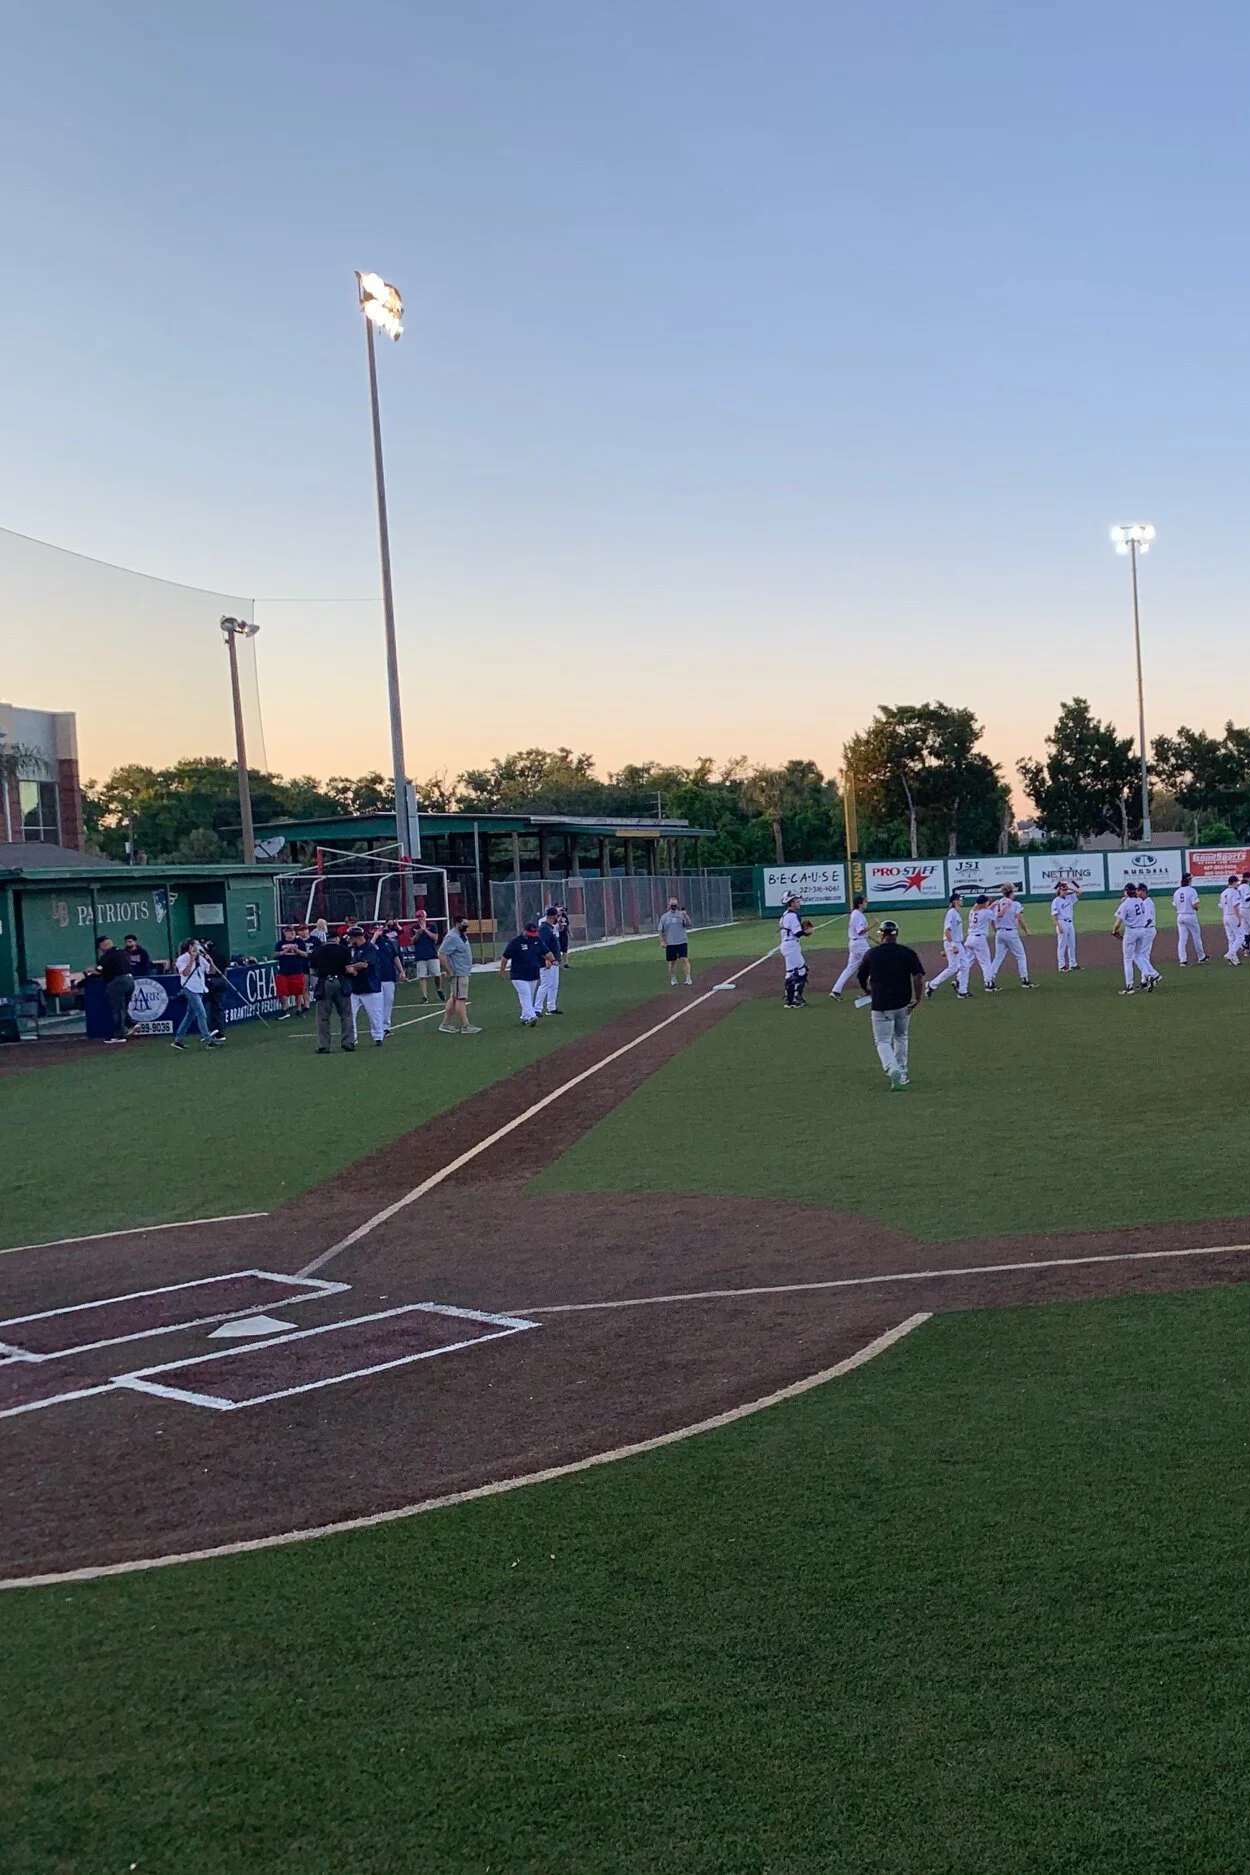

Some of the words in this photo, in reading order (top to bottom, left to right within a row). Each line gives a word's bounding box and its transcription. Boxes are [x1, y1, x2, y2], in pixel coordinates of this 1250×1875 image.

[956, 860, 980, 871] JSI
[1042, 869, 1092, 879] NETTING
[77, 901, 149, 926] PATRIOTS
[246, 966, 280, 1003] CHA
